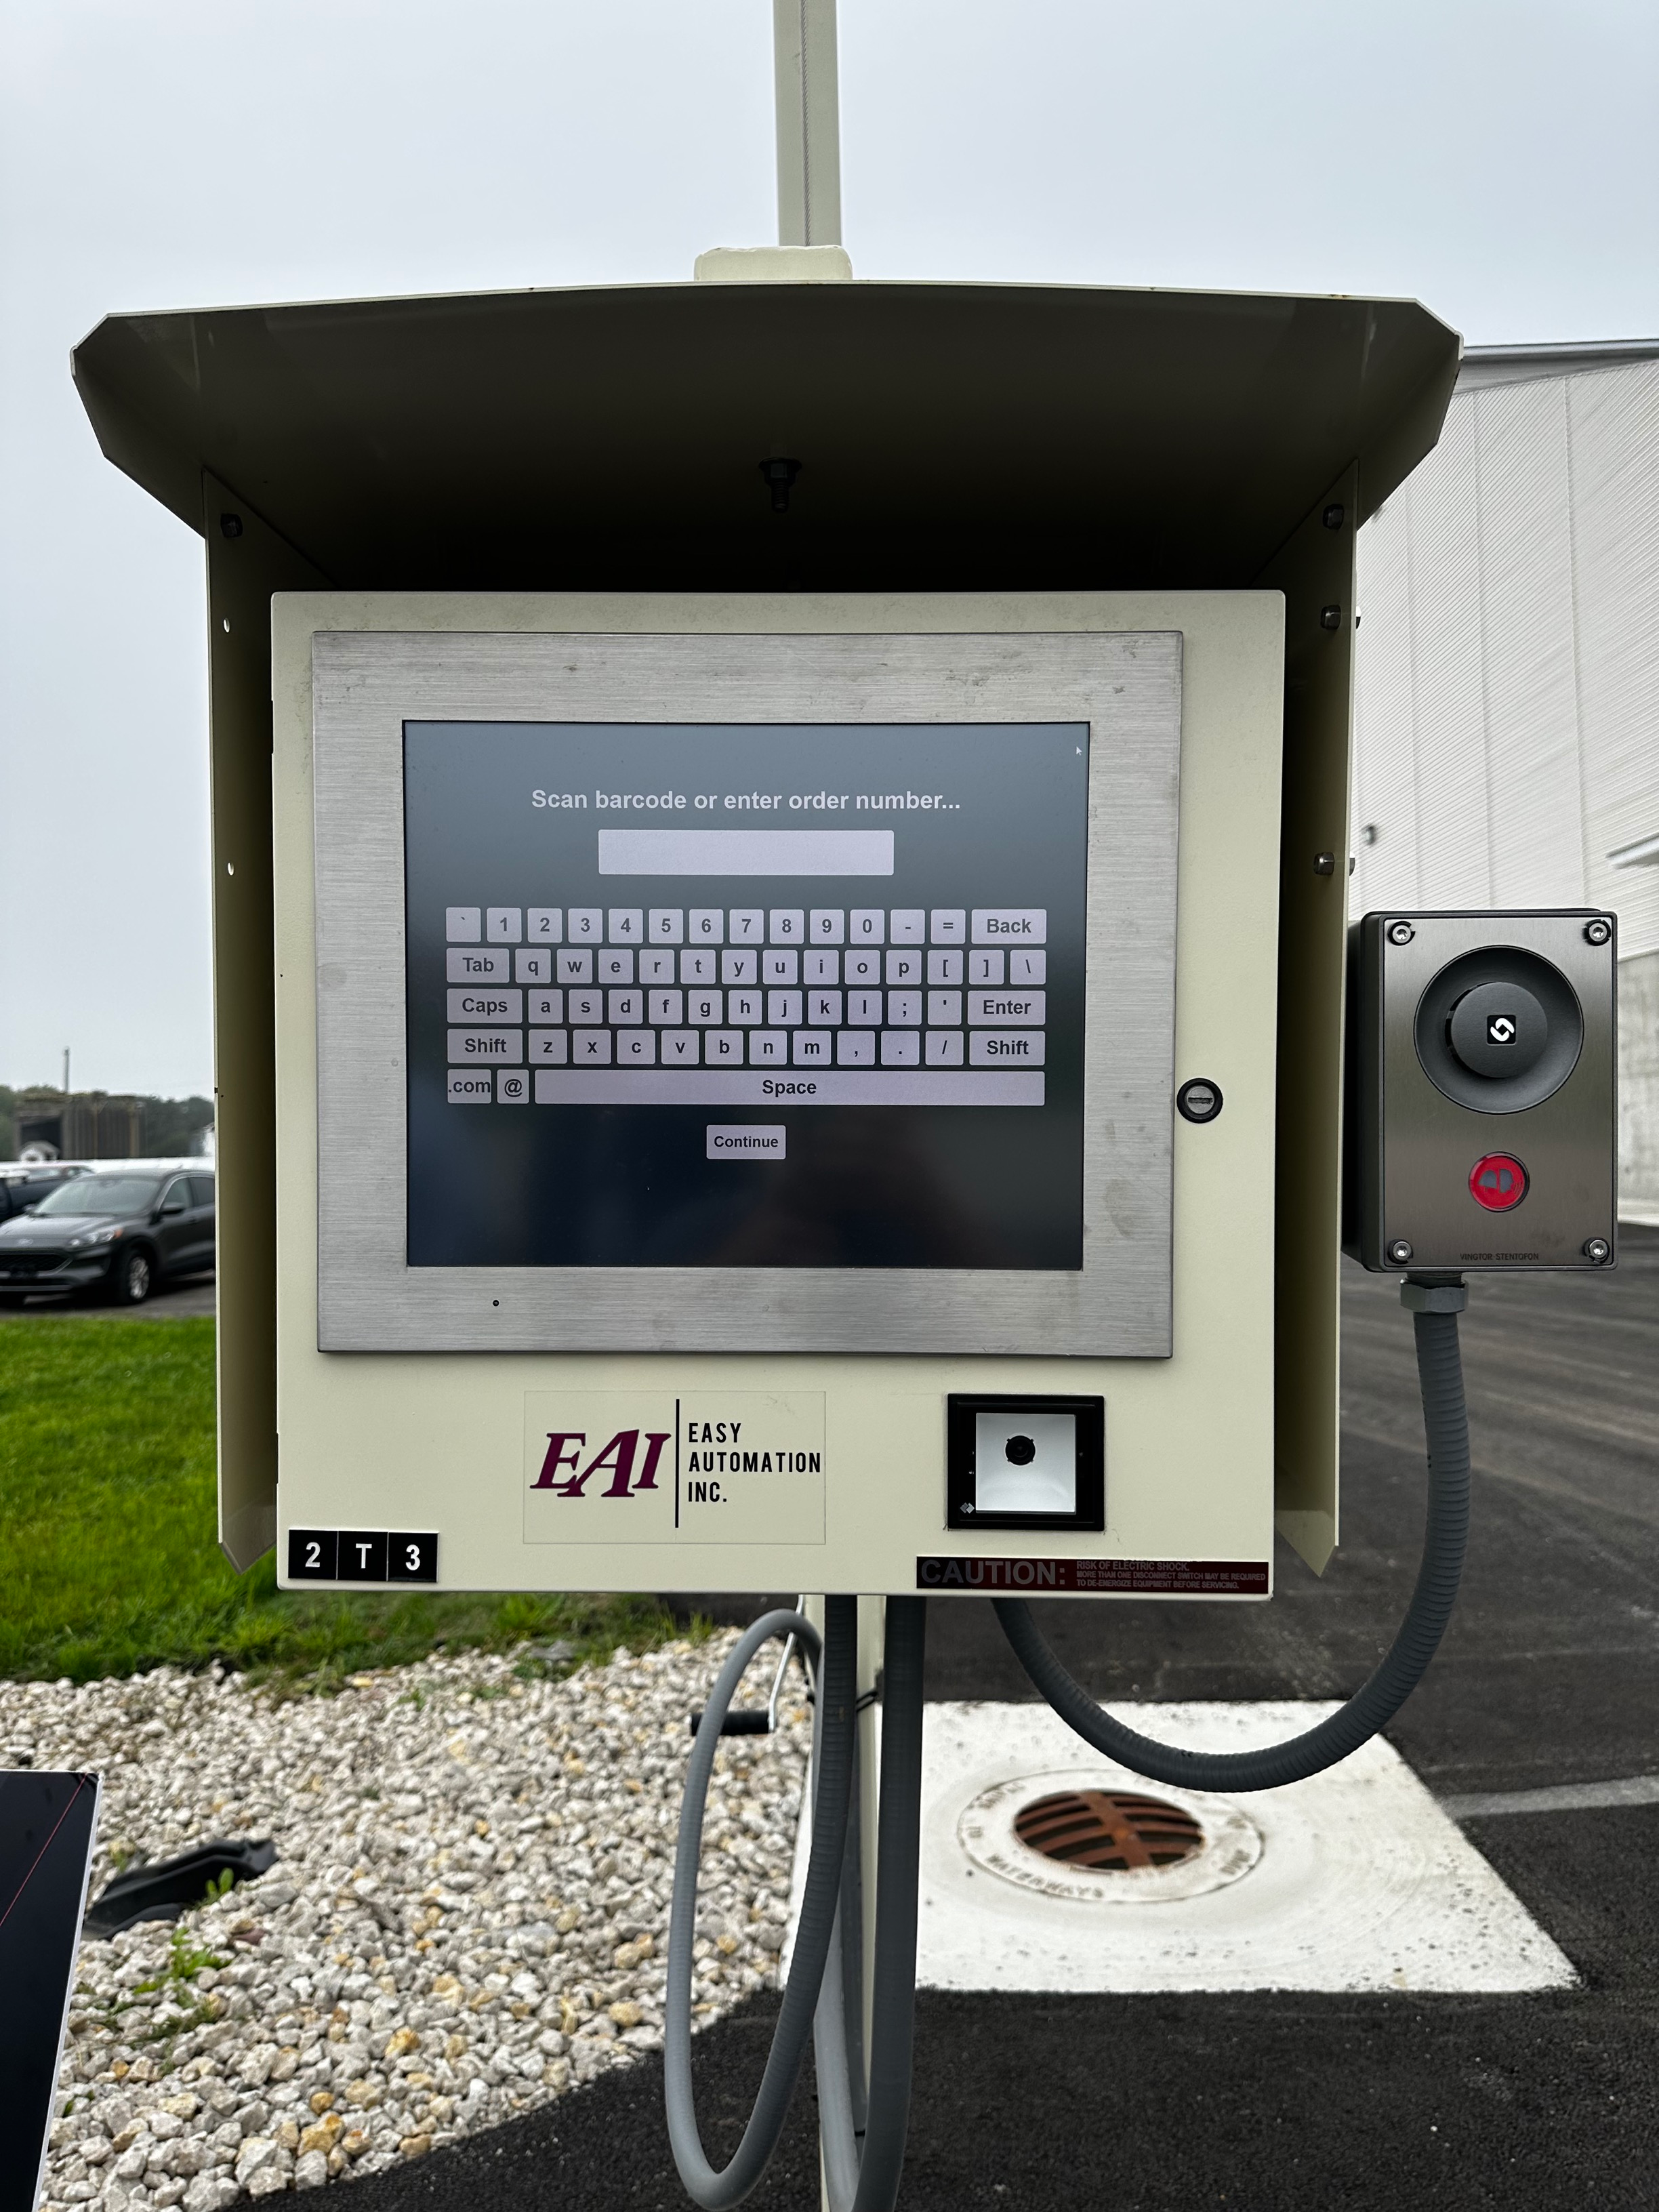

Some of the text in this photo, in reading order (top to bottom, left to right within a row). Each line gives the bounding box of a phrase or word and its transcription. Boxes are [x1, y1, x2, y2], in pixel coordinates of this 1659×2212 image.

[531, 790, 960, 809] Scan barcode or enter order number...
[499, 917, 508, 932] 1
[539, 917, 550, 933] 2
[580, 918, 590, 933] 3
[620, 918, 632, 933] 4
[661, 918, 672, 933] 5
[701, 918, 712, 933] 6
[741, 918, 752, 933] 7
[781, 918, 792, 933] 8
[821, 918, 832, 934] 9
[862, 918, 872, 934] 0
[987, 918, 1032, 933] Back
[462, 957, 1031, 978] Tab q w e r t y u i o p [ ] \
[462, 998, 508, 1017] Caps
[540, 1001, 551, 1013] a
[581, 1002, 591, 1013] s
[620, 998, 631, 1013] d
[662, 999, 670, 1014] f
[700, 1002, 711, 1017] g
[740, 999, 750, 1014] h
[781, 999, 787, 1018] j
[820, 1000, 830, 1015] k
[863, 1000, 867, 1015] l
[903, 1002, 907, 1017] ;
[983, 1000, 1031, 1015] Enter
[464, 1038, 507, 1053] Shift
[543, 1042, 553, 1053] z
[587, 1042, 598, 1053] x
[631, 1042, 642, 1054] c
[675, 1042, 686, 1054] v
[719, 1039, 730, 1054] b
[763, 1042, 773, 1054] n
[804, 1042, 820, 1054] m
[941, 1040, 947, 1054] /
[986, 1040, 1029, 1055] Shift
[448, 1078, 817, 1098] .com @ Space
[714, 1135, 779, 1148] Continue
[689, 1422, 741, 1443] EASY
[529, 1429, 672, 1498] EAI
[689, 1452, 821, 1473] AUTOMATION
[688, 1481, 727, 1502] INC.
[921, 1560, 1065, 1584] CAUTION:
[1077, 1561, 1189, 1571] RISK OF ELECTRIC SHOCK.
[1087, 1579, 1132, 1587] DE-ENERGIZE
